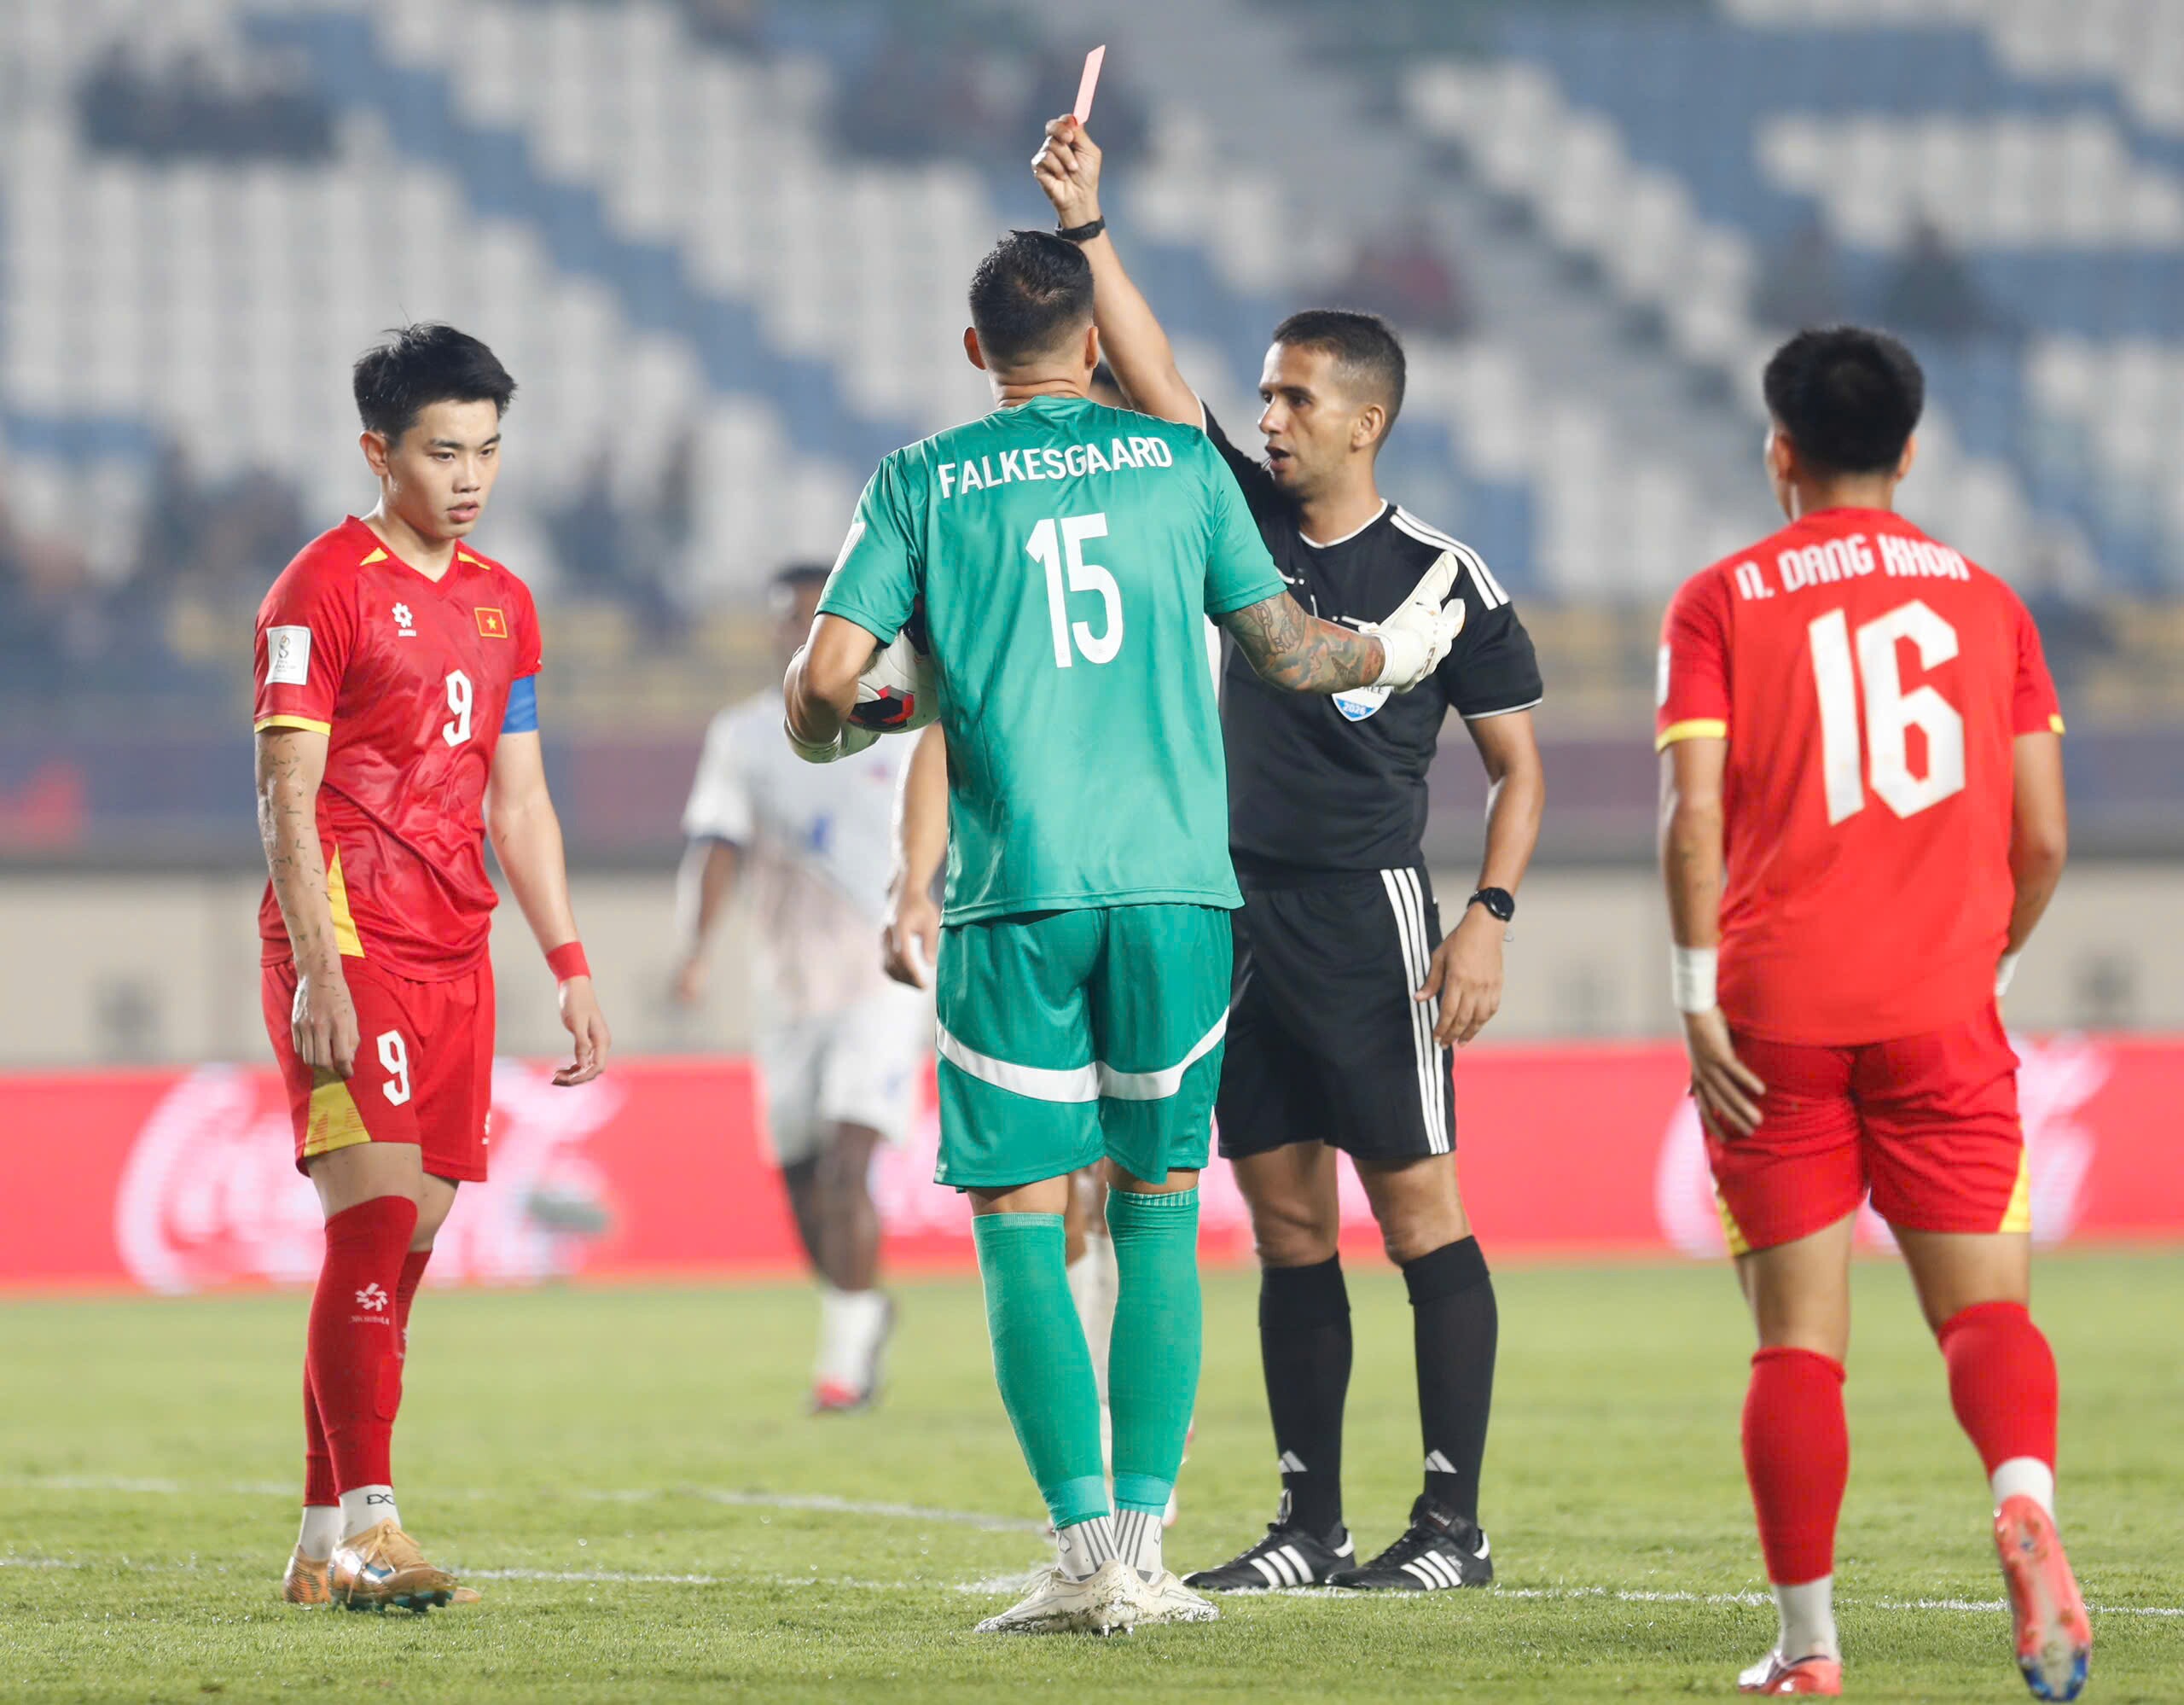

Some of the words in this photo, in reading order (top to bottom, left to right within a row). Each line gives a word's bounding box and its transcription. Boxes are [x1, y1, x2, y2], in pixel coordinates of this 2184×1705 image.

[938, 436, 1174, 499] FALKESGAARD
[1025, 512, 1124, 669] 15
[1777, 532, 1875, 593] DANG
[442, 669, 473, 748] 9
[1343, 701, 1367, 715] 2026
[1808, 599, 1966, 827] 16
[376, 1029, 411, 1107] 9
